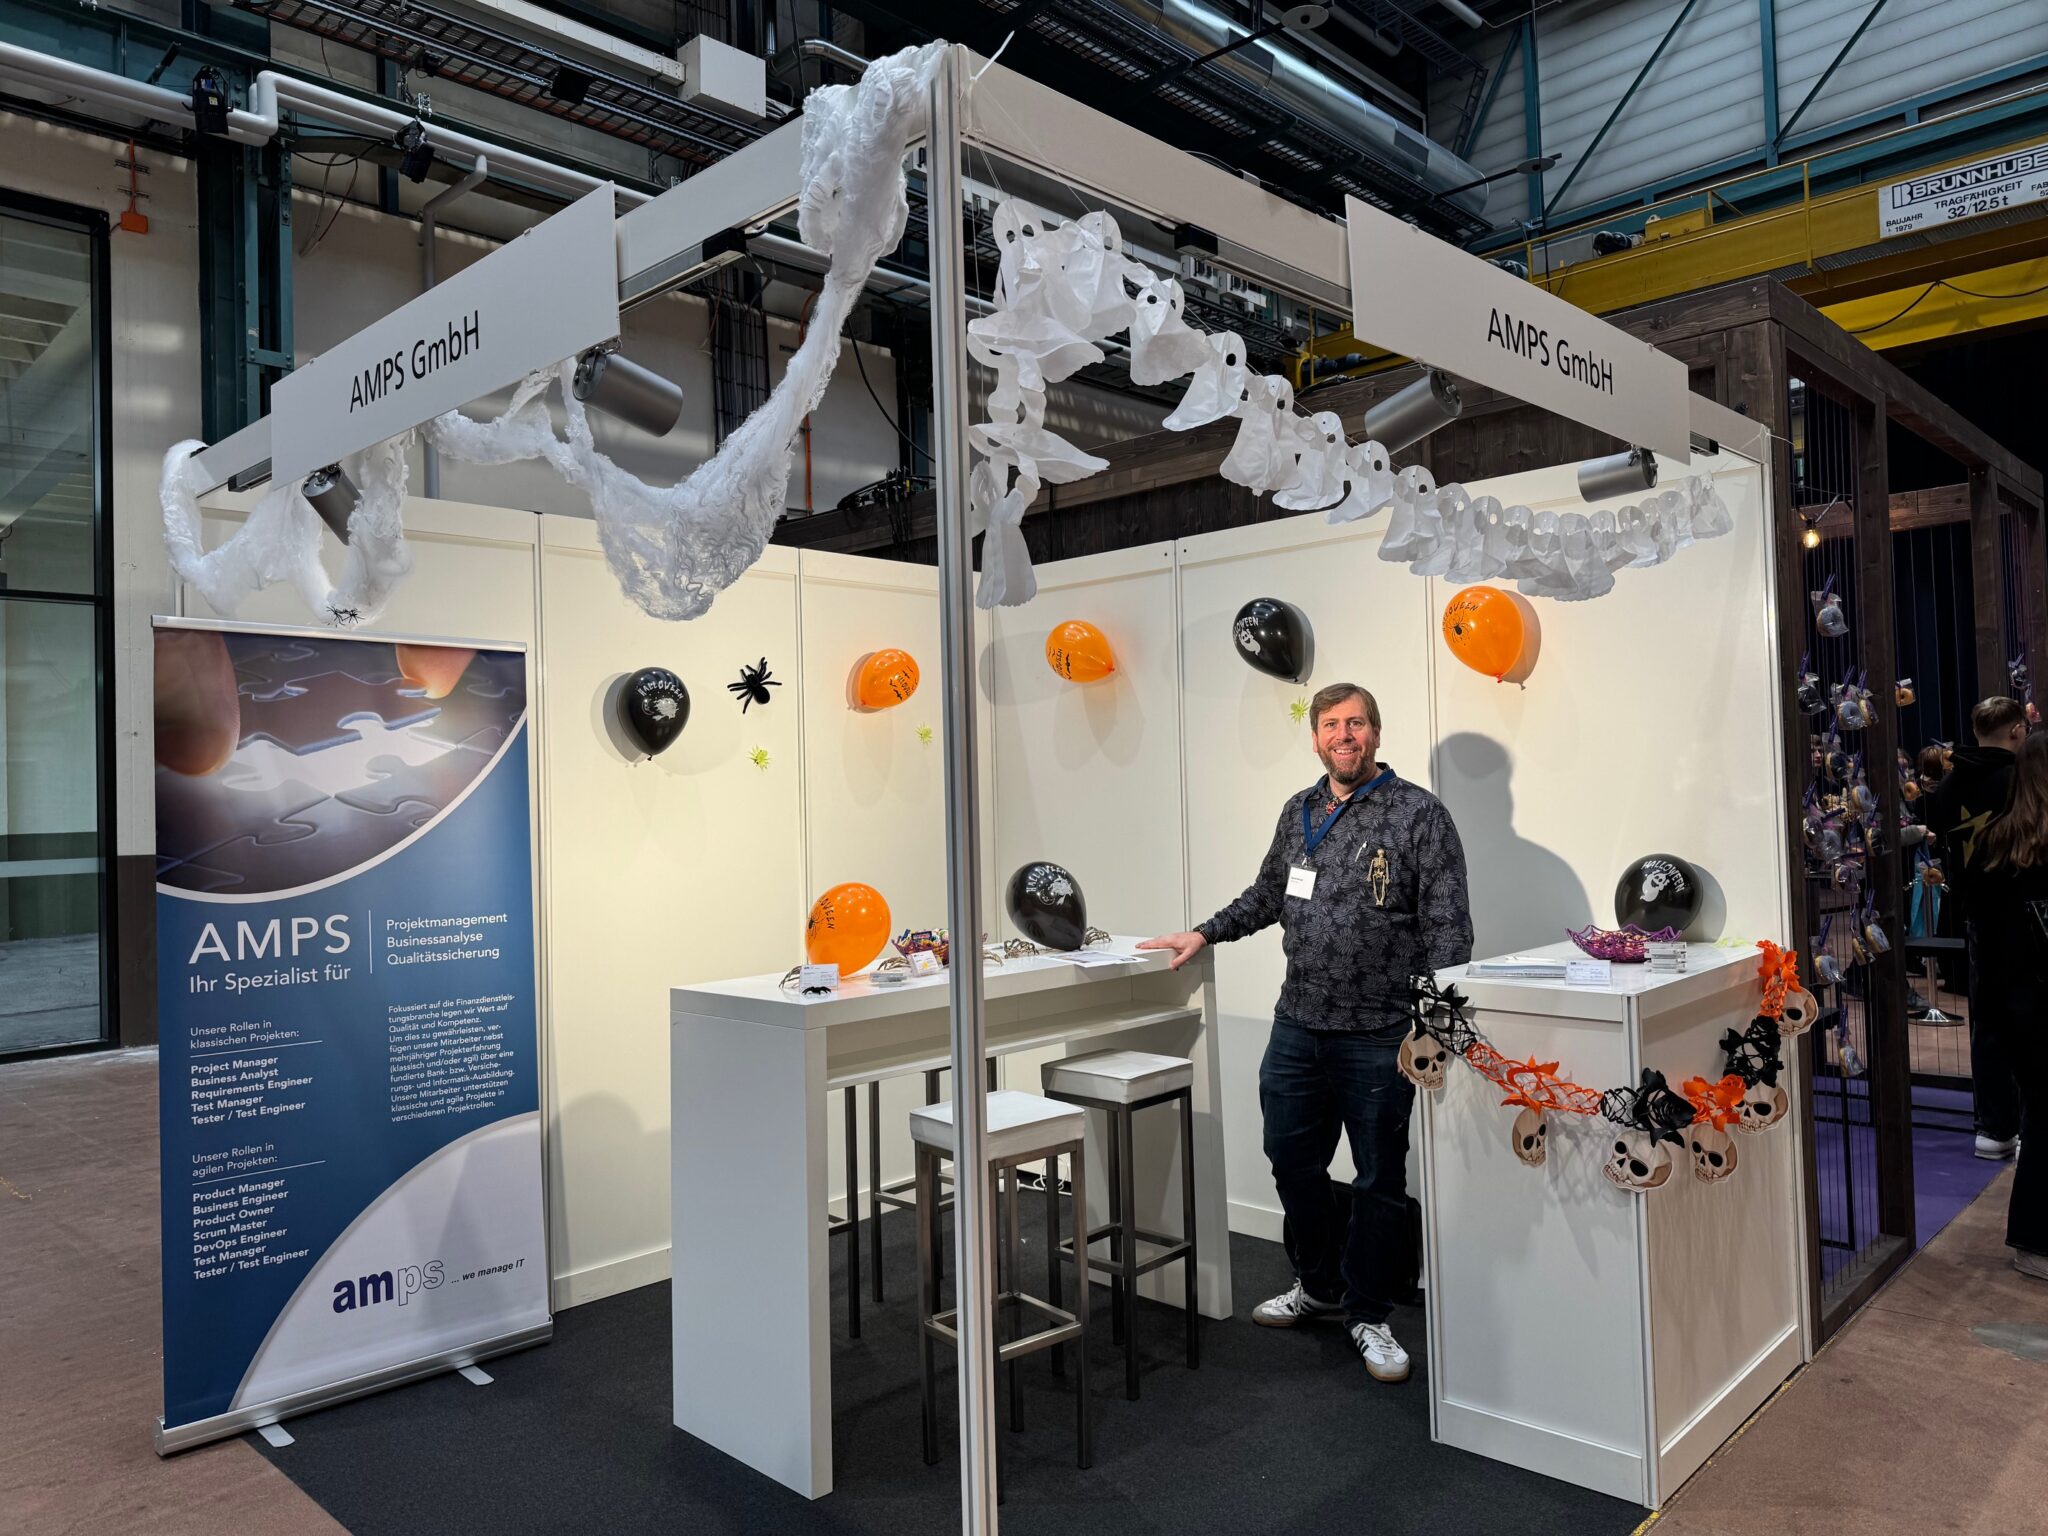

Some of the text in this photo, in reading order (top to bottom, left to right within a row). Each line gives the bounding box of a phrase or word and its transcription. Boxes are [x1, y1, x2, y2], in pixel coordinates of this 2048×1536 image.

[1934, 180, 2023, 210] TRAGFÄHIGKEIT
[1948, 195, 2009, 220] 32/12,5 t
[1886, 213, 1923, 227] BAUJAHR
[1896, 224, 1912, 233] 1979
[350, 310, 479, 413] AMPS GmbH
[1488, 308, 1613, 395] AMPS GmbH
[1641, 860, 1685, 893] HALLOWEEN
[387, 913, 508, 931] Projektmanagement
[188, 914, 351, 964] AMPS
[387, 932, 483, 948] Businessanalyse
[387, 948, 500, 966] Qualitätssicherung
[190, 964, 351, 995] Ihr Spezialist für
[388, 994, 516, 1013] Fokussiert auf die Finanzdienstleis-
[388, 1012, 440, 1024] tungsbranche
[442, 1008, 462, 1019] legen
[476, 1005, 495, 1013] Wert
[496, 1003, 509, 1011] auf
[190, 1020, 272, 1037] Unsere Rollen in
[389, 1017, 482, 1033] Qualität und Kompetenz.
[390, 1035, 403, 1043] Um
[404, 1032, 420, 1041] dies
[432, 1026, 486, 1040] gewährleisten,
[190, 1030, 299, 1049] klassischen Projekten:
[390, 1033, 504, 1054] fügen unsere Mitarbeiter nebst
[390, 1043, 501, 1063] mehrjähriger Projekterfahrung
[390, 1050, 514, 1074] (klassisch und/oder agil) über eine
[191, 1056, 279, 1075] Project Manager
[390, 1062, 502, 1083] fundierte Bank- bzw. Versiche-
[191, 1067, 279, 1087] Business Analyst
[390, 1084, 415, 1093] rungs-
[416, 1081, 431, 1089] und
[192, 1076, 313, 1100] Requirements Engineer
[391, 1080, 509, 1103] Unsere Mitarbeiter unterstützen
[191, 1094, 264, 1113] Test Manager
[392, 1102, 428, 1113] klassische
[430, 1098, 445, 1106] und
[446, 1096, 464, 1105] agile
[466, 1092, 496, 1103] Projekte
[392, 1101, 496, 1122] verschiedenen Projektrollen.
[192, 1102, 306, 1126] Tester / Test Engineer
[192, 1143, 274, 1164] Unsere Rollen in
[192, 1156, 278, 1178] agilen Projekten:
[193, 1178, 286, 1202] Product Manager
[193, 1190, 289, 1215] Business Engineer
[194, 1206, 275, 1228] Product Owner
[194, 1219, 268, 1241] Scrum Master
[194, 1228, 288, 1254] DevOps Engineer
[194, 1245, 267, 1267] Test Manager
[194, 1249, 310, 1280] Tester / Test Engineer
[333, 1260, 445, 1314] amps
[462, 1272, 476, 1281] we
[478, 1264, 514, 1278] manage
[516, 1258, 525, 1269] IT
